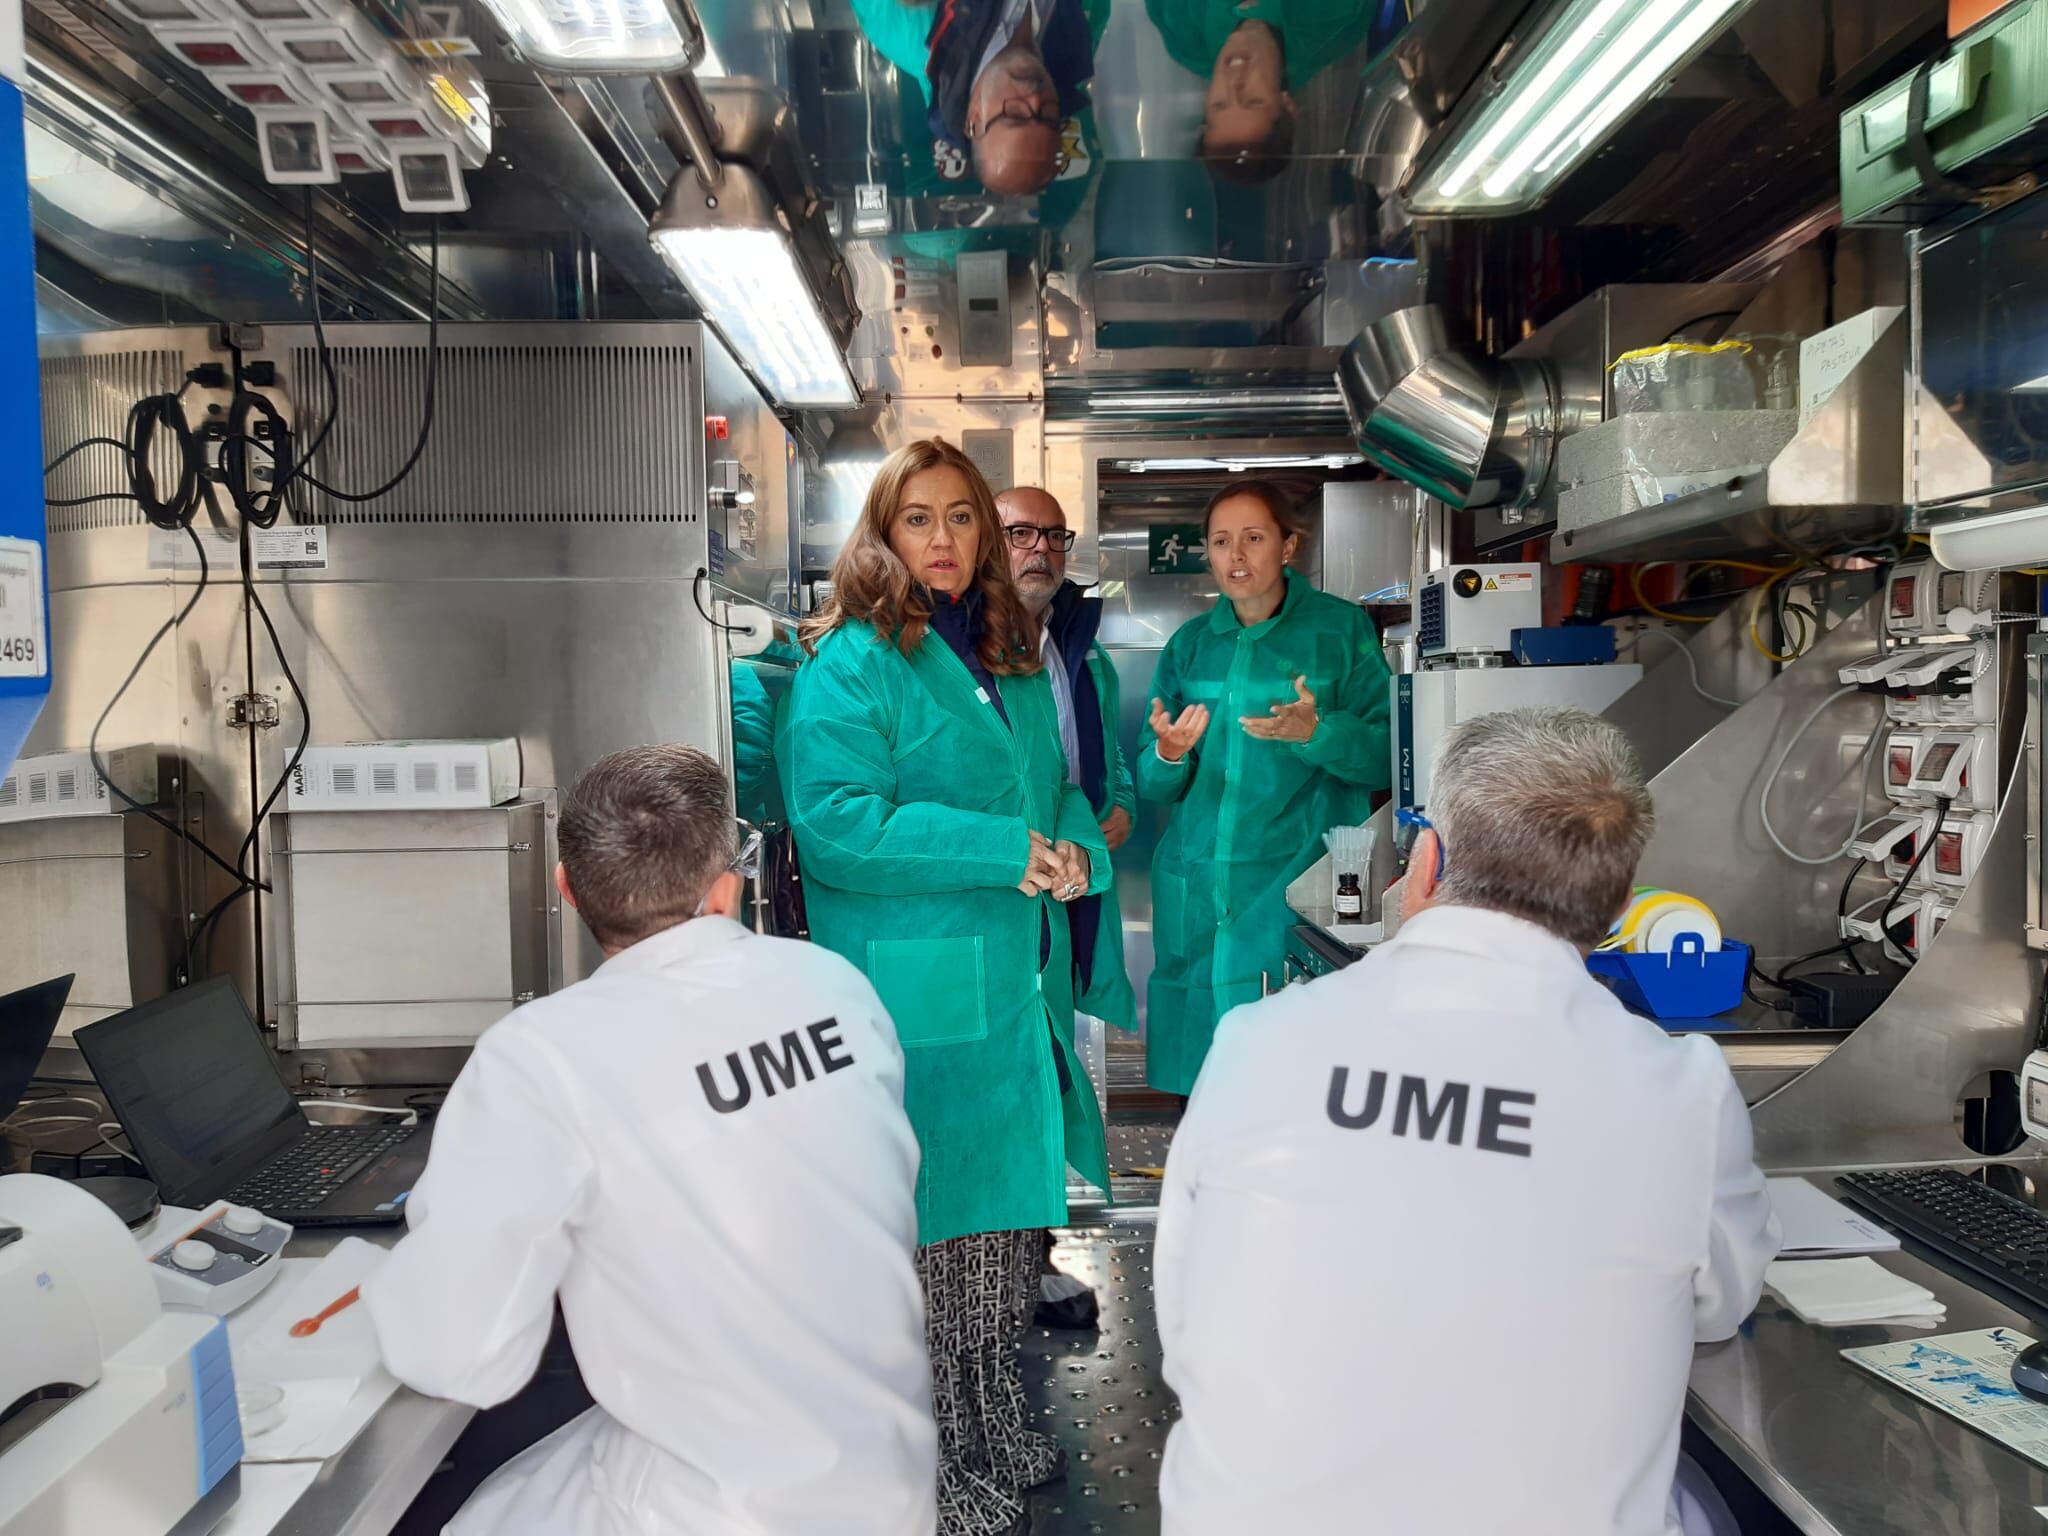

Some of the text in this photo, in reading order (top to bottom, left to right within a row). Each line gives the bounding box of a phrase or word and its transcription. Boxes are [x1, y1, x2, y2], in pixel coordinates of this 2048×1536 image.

[0, 638, 34, 662] 469
[293, 763, 304, 796] MAPA
[695, 1015, 855, 1114] UME
[1326, 1066, 1536, 1158] UME
